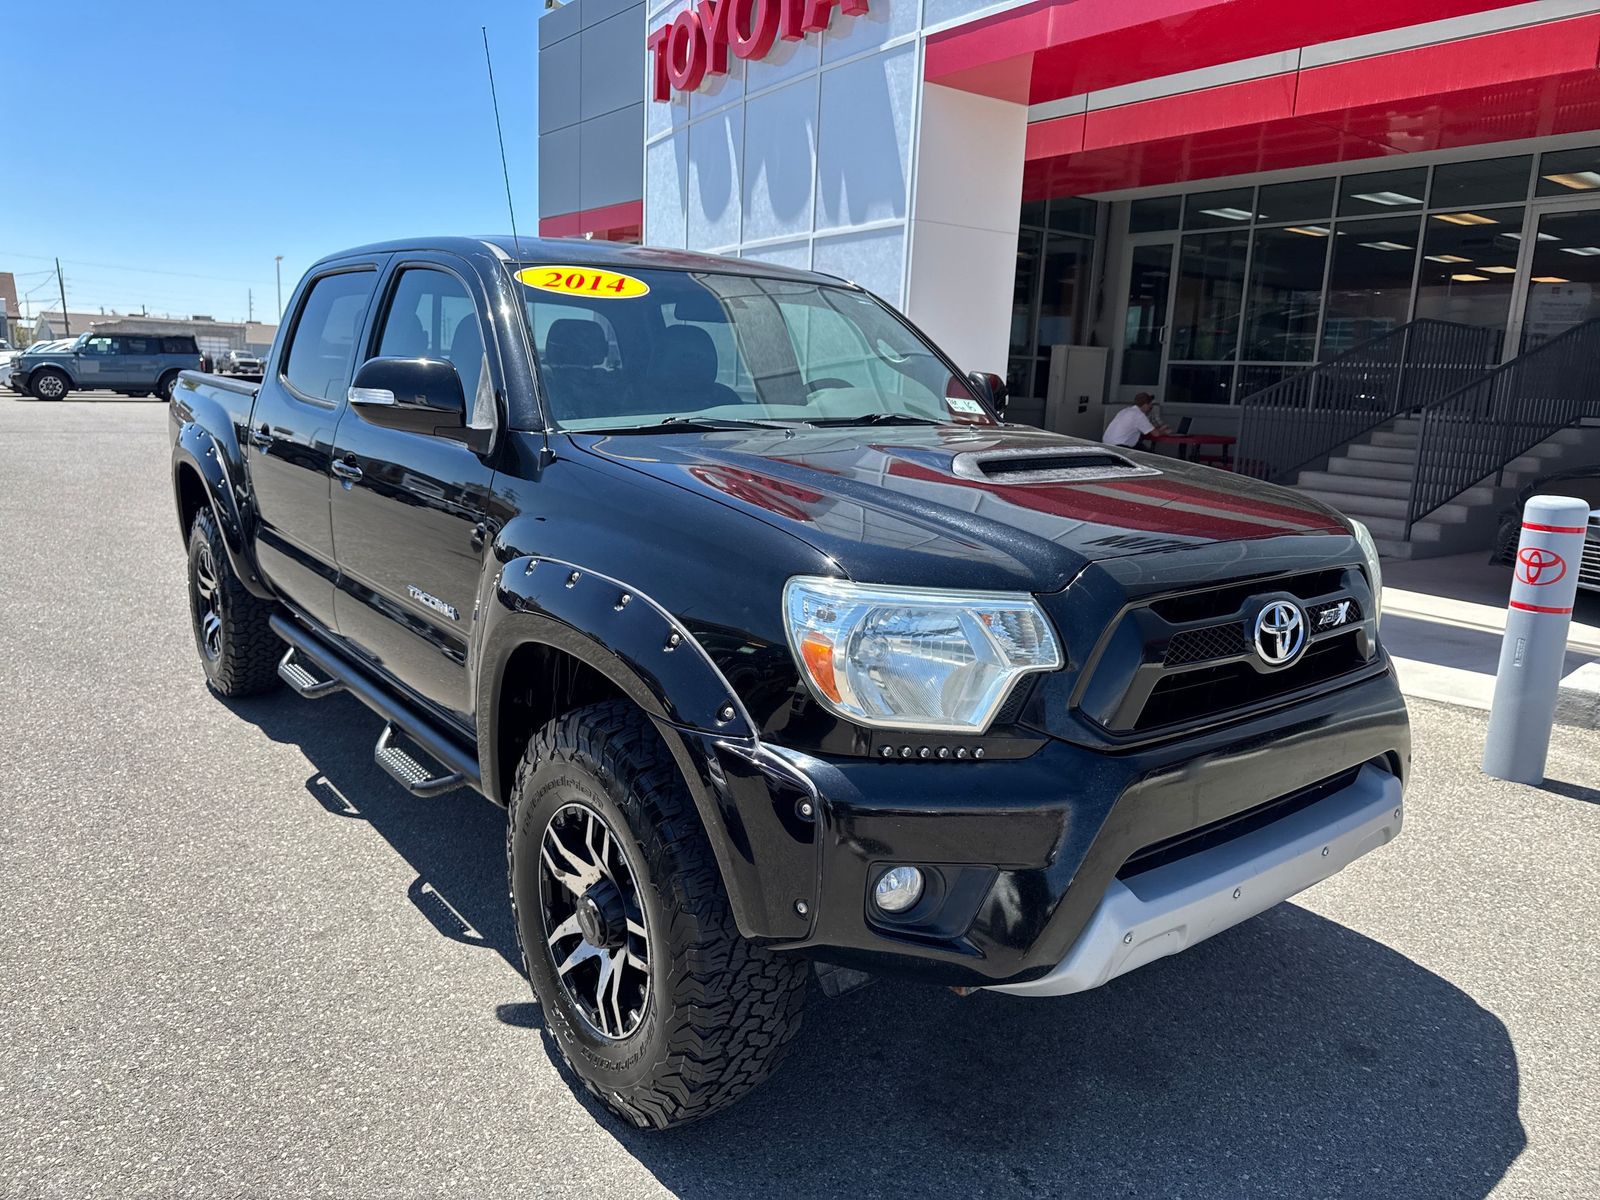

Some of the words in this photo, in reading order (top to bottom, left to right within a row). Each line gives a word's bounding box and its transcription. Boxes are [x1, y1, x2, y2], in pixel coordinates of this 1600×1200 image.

[647, 0, 869, 102] TOYO
[543, 272, 626, 292] 2014
[406, 584, 460, 620] TACOMA
